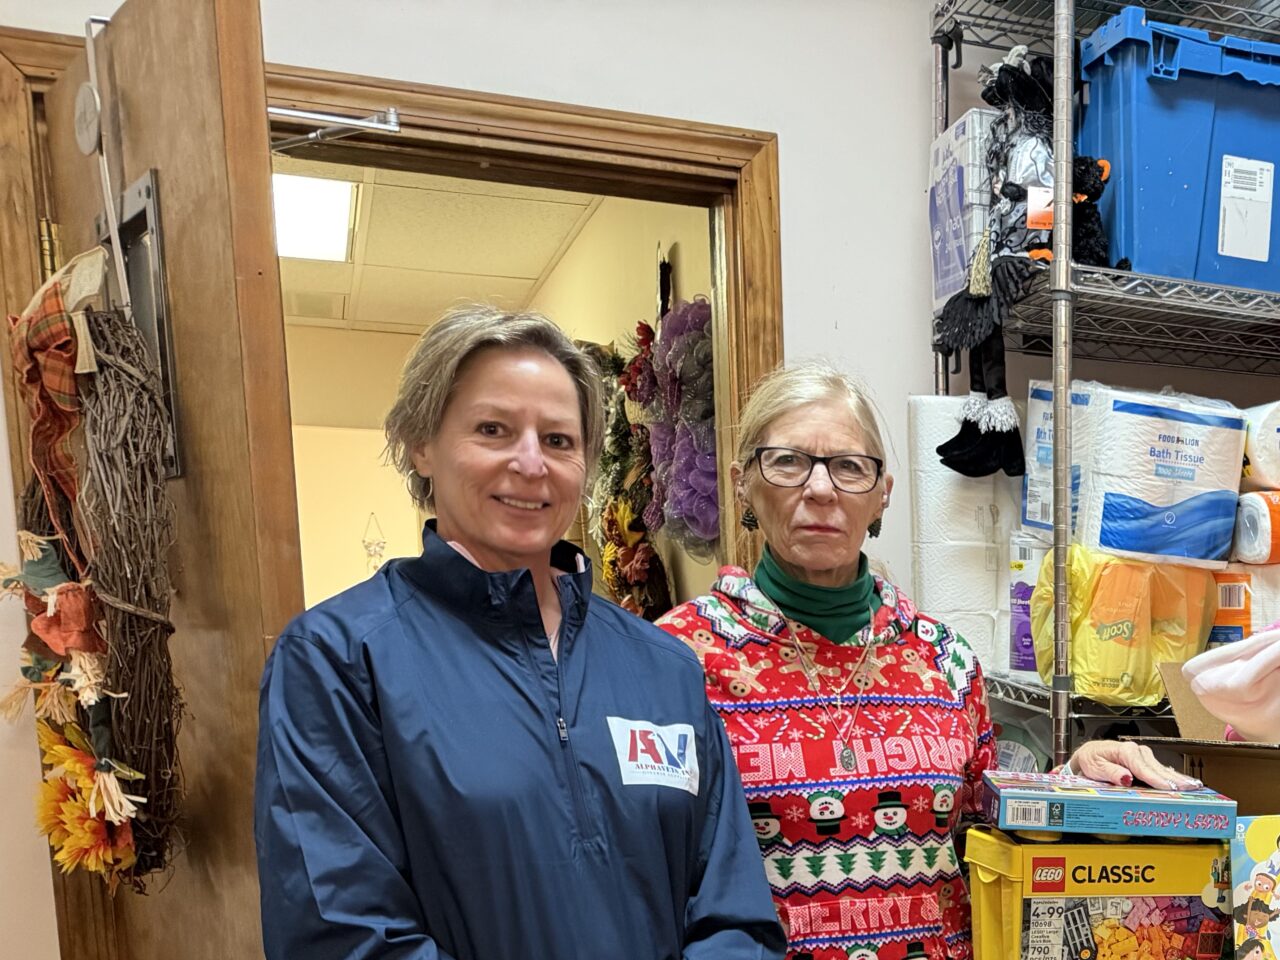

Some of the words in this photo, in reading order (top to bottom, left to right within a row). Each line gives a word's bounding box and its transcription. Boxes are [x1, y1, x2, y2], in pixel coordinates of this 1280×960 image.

[1158, 434, 1175, 444] FOOD
[1185, 438, 1199, 447] LION
[1149, 446, 1171, 459] Bath
[1175, 449, 1205, 464] Tissue
[1102, 621, 1132, 641] Scott
[1123, 810, 1181, 828] CANDY
[1184, 813, 1230, 830] LAND
[1034, 867, 1064, 881] LEGO
[788, 897, 912, 936] MERRY
[919, 893, 940, 921] &
[1032, 906, 1064, 918] 4-99
[1031, 946, 1050, 955] 790
